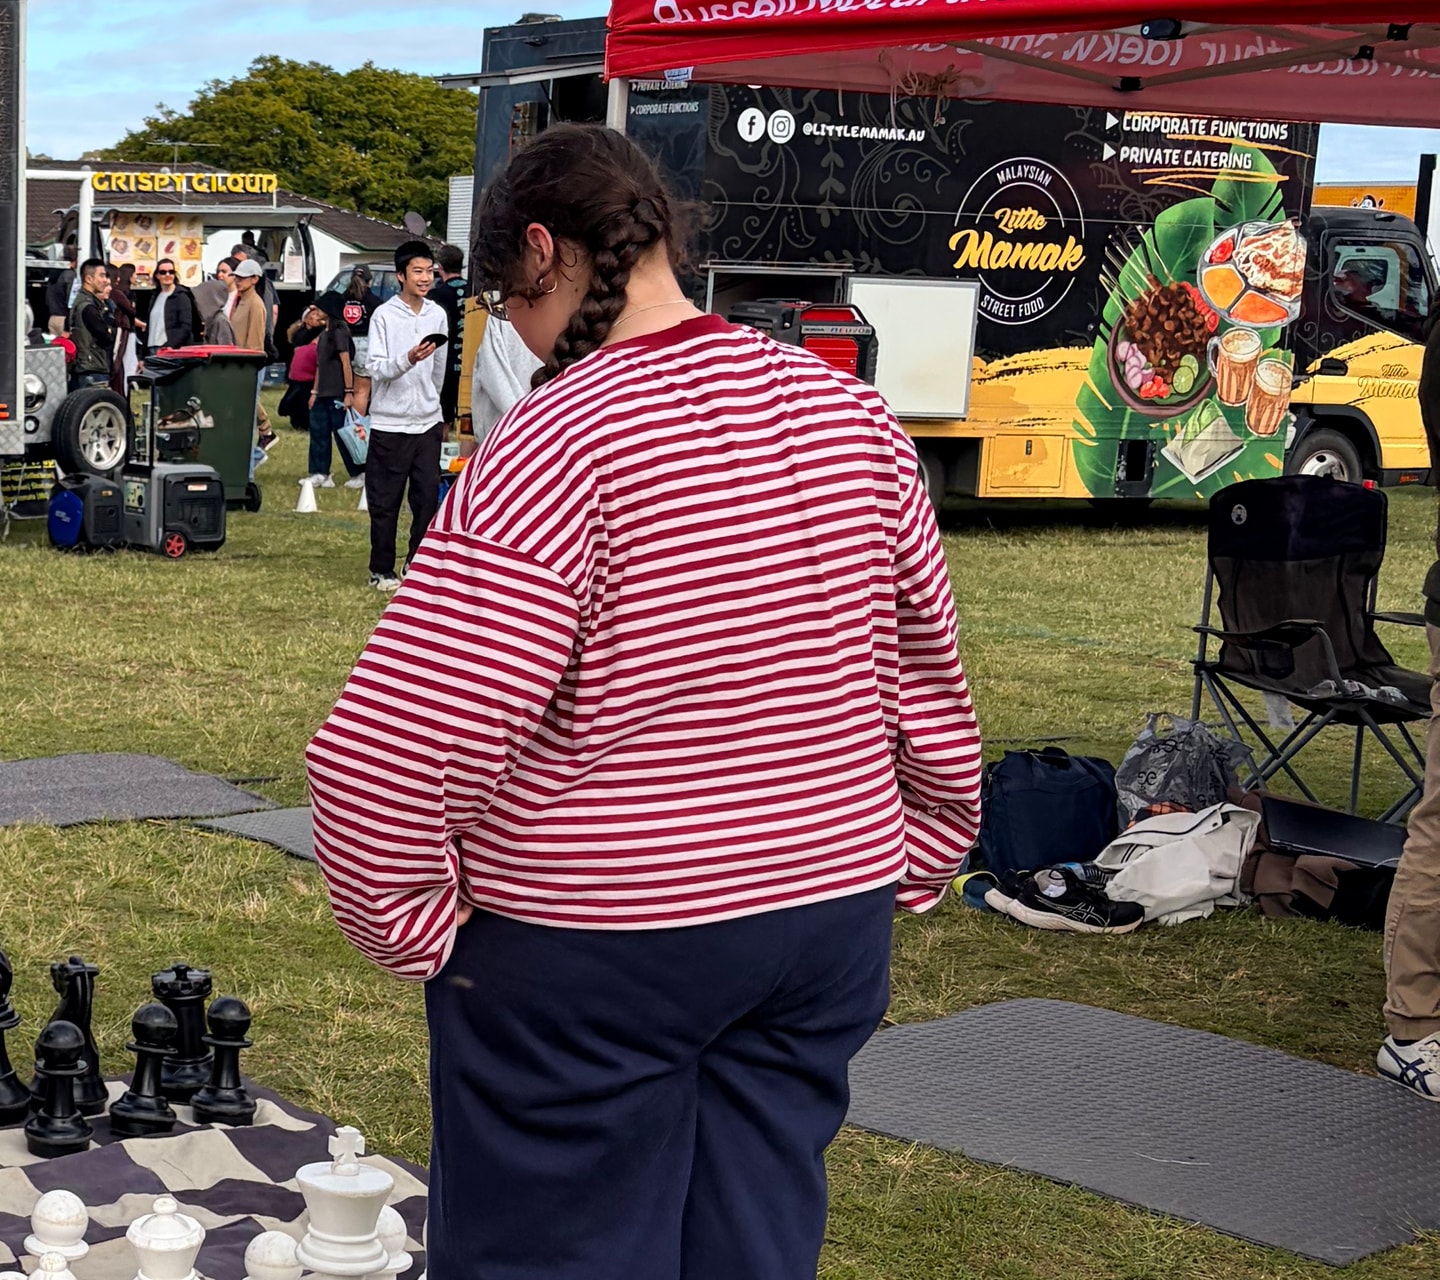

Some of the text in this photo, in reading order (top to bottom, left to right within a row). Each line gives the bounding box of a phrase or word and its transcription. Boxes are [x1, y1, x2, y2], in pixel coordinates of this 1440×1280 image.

[635, 102, 700, 115] CORPORATE FUNCTIONS
[802, 122, 926, 142] @LITTLEMAMAK.AU
[1122, 117, 1289, 140] CORPORATE FUNCTIONS
[1119, 146, 1253, 169] PRIVATE CATERING
[92, 172, 185, 193] CRISPY
[996, 165, 1052, 188] MALAYSIAN
[994, 207, 1048, 234] Little
[948, 229, 1086, 272] Mamak
[980, 294, 1045, 318] STREET FOOD
[1358, 375, 1418, 400] Mama
